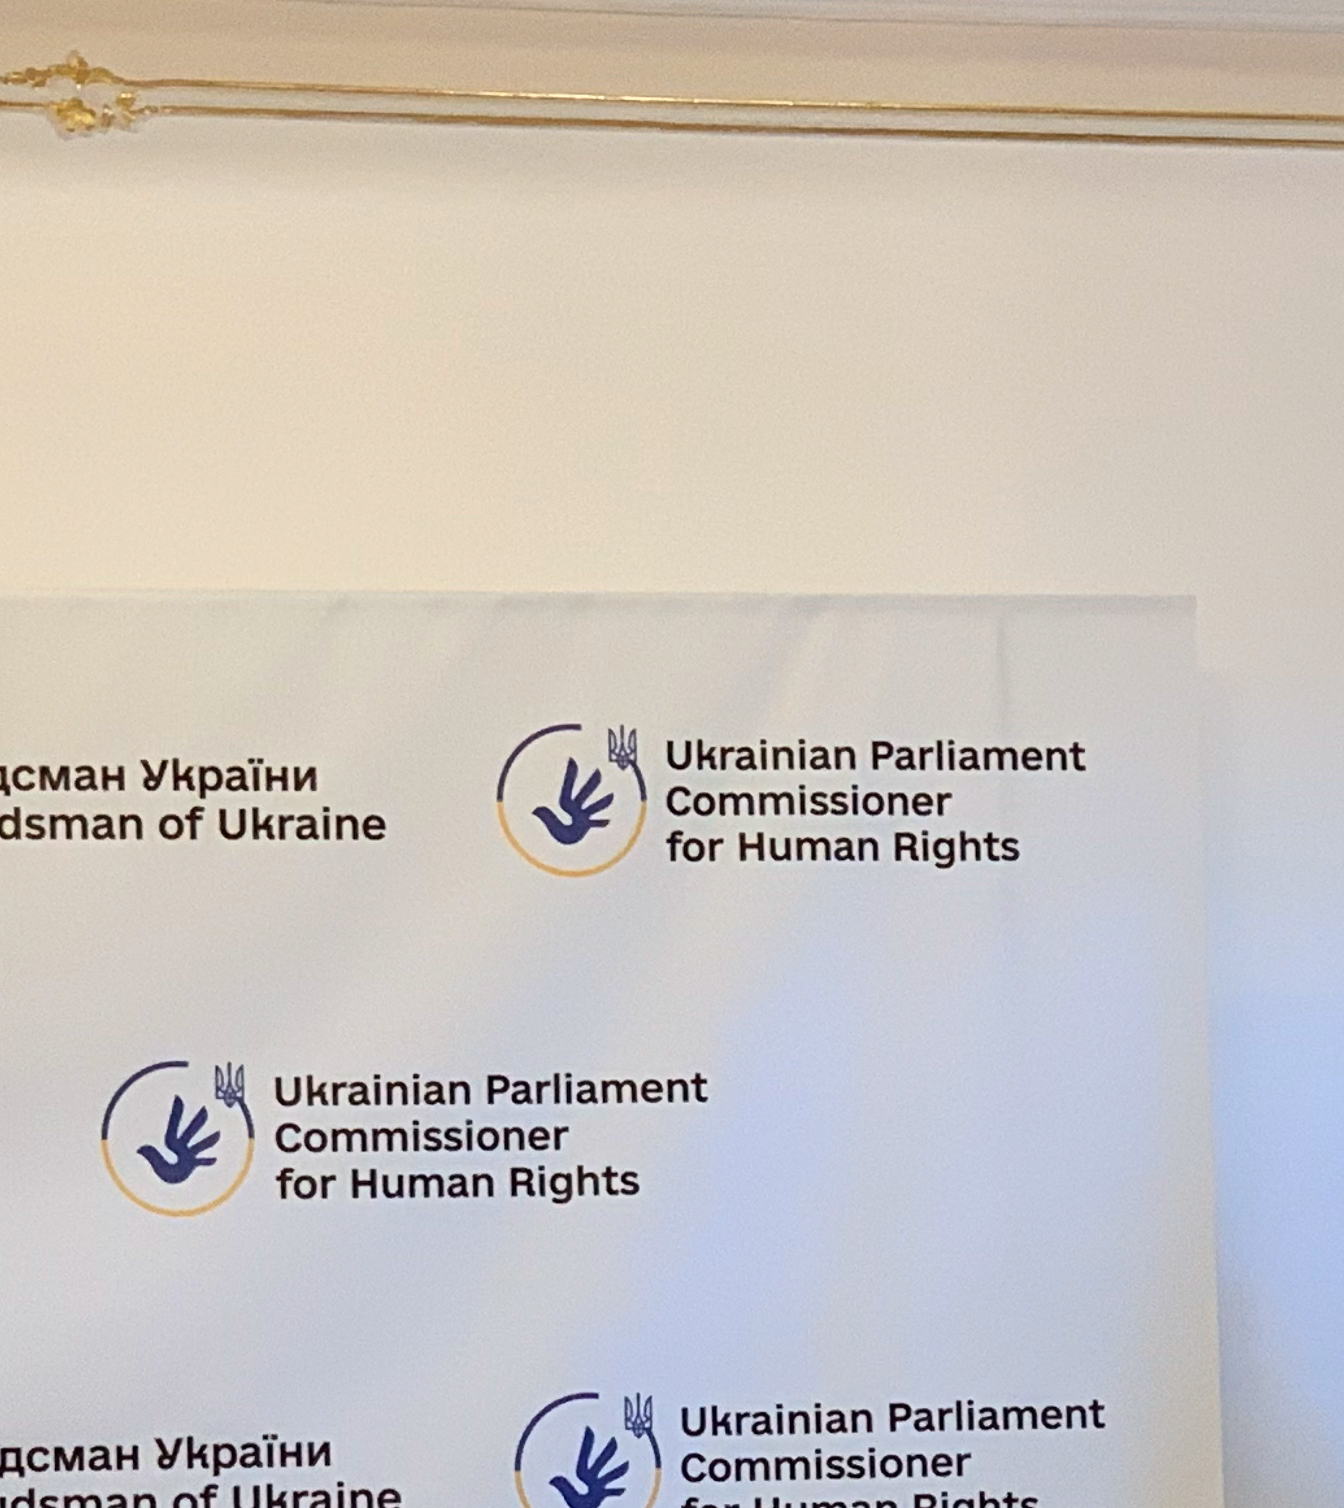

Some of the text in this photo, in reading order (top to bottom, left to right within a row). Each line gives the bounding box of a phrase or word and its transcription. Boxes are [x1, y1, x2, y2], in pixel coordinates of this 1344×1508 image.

[666, 738, 1086, 772] Ukrainian Parliament
[140, 757, 317, 800] України
[666, 784, 953, 817] Commissioner
[158, 806, 205, 840] of
[218, 806, 386, 841] Ukraine
[666, 829, 1020, 869] for Human Rights
[275, 1072, 709, 1107] Ukrainian Parliament
[275, 1119, 569, 1153] Commissioner
[275, 1165, 640, 1204] for Human Rights
[681, 1399, 1106, 1437] Ukrainian Parliament
[155, 1433, 331, 1477] України
[681, 1447, 972, 1483] Commissioner
